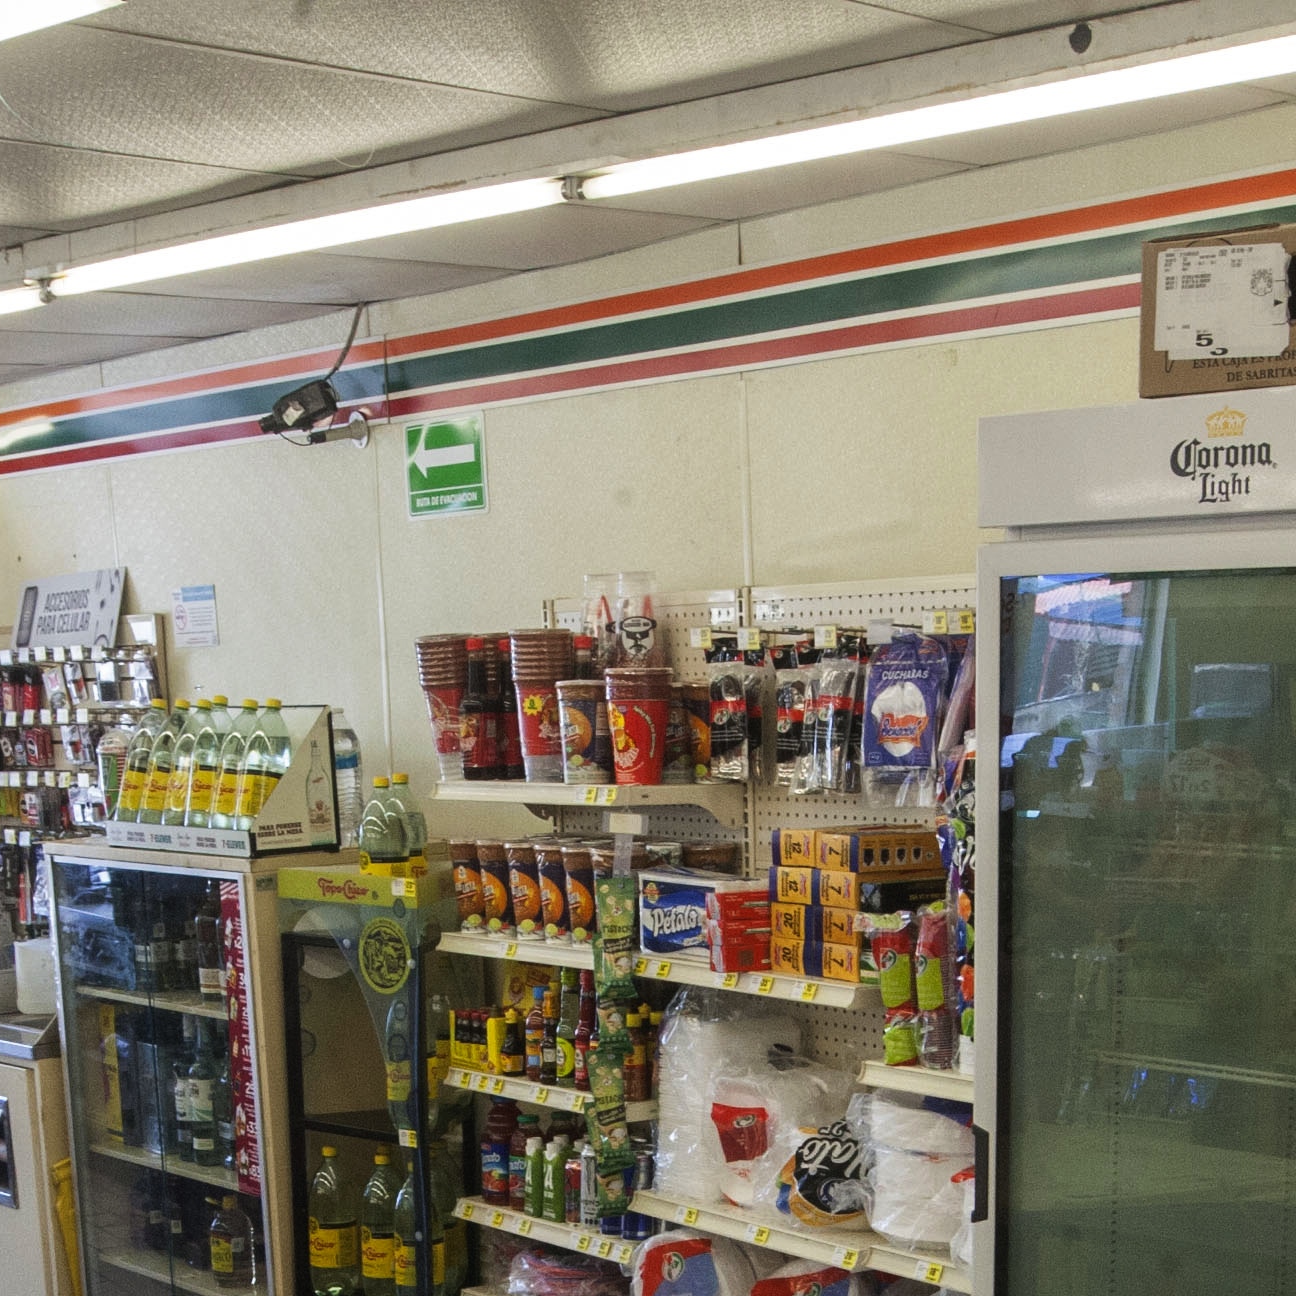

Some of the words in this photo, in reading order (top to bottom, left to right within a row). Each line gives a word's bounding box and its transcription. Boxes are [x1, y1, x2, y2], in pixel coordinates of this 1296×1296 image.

[1195, 333, 1214, 348] 5
[1192, 357, 1220, 370] ESTA
[1222, 355, 1249, 369] CAJA
[1226, 371, 1244, 383] DE
[1170, 436, 1276, 480] Corona
[1198, 470, 1252, 504] Light
[44, 588, 90, 613] ACCESORIOS
[36, 613, 57, 635] PARA
[55, 611, 91, 634] CELULAR
